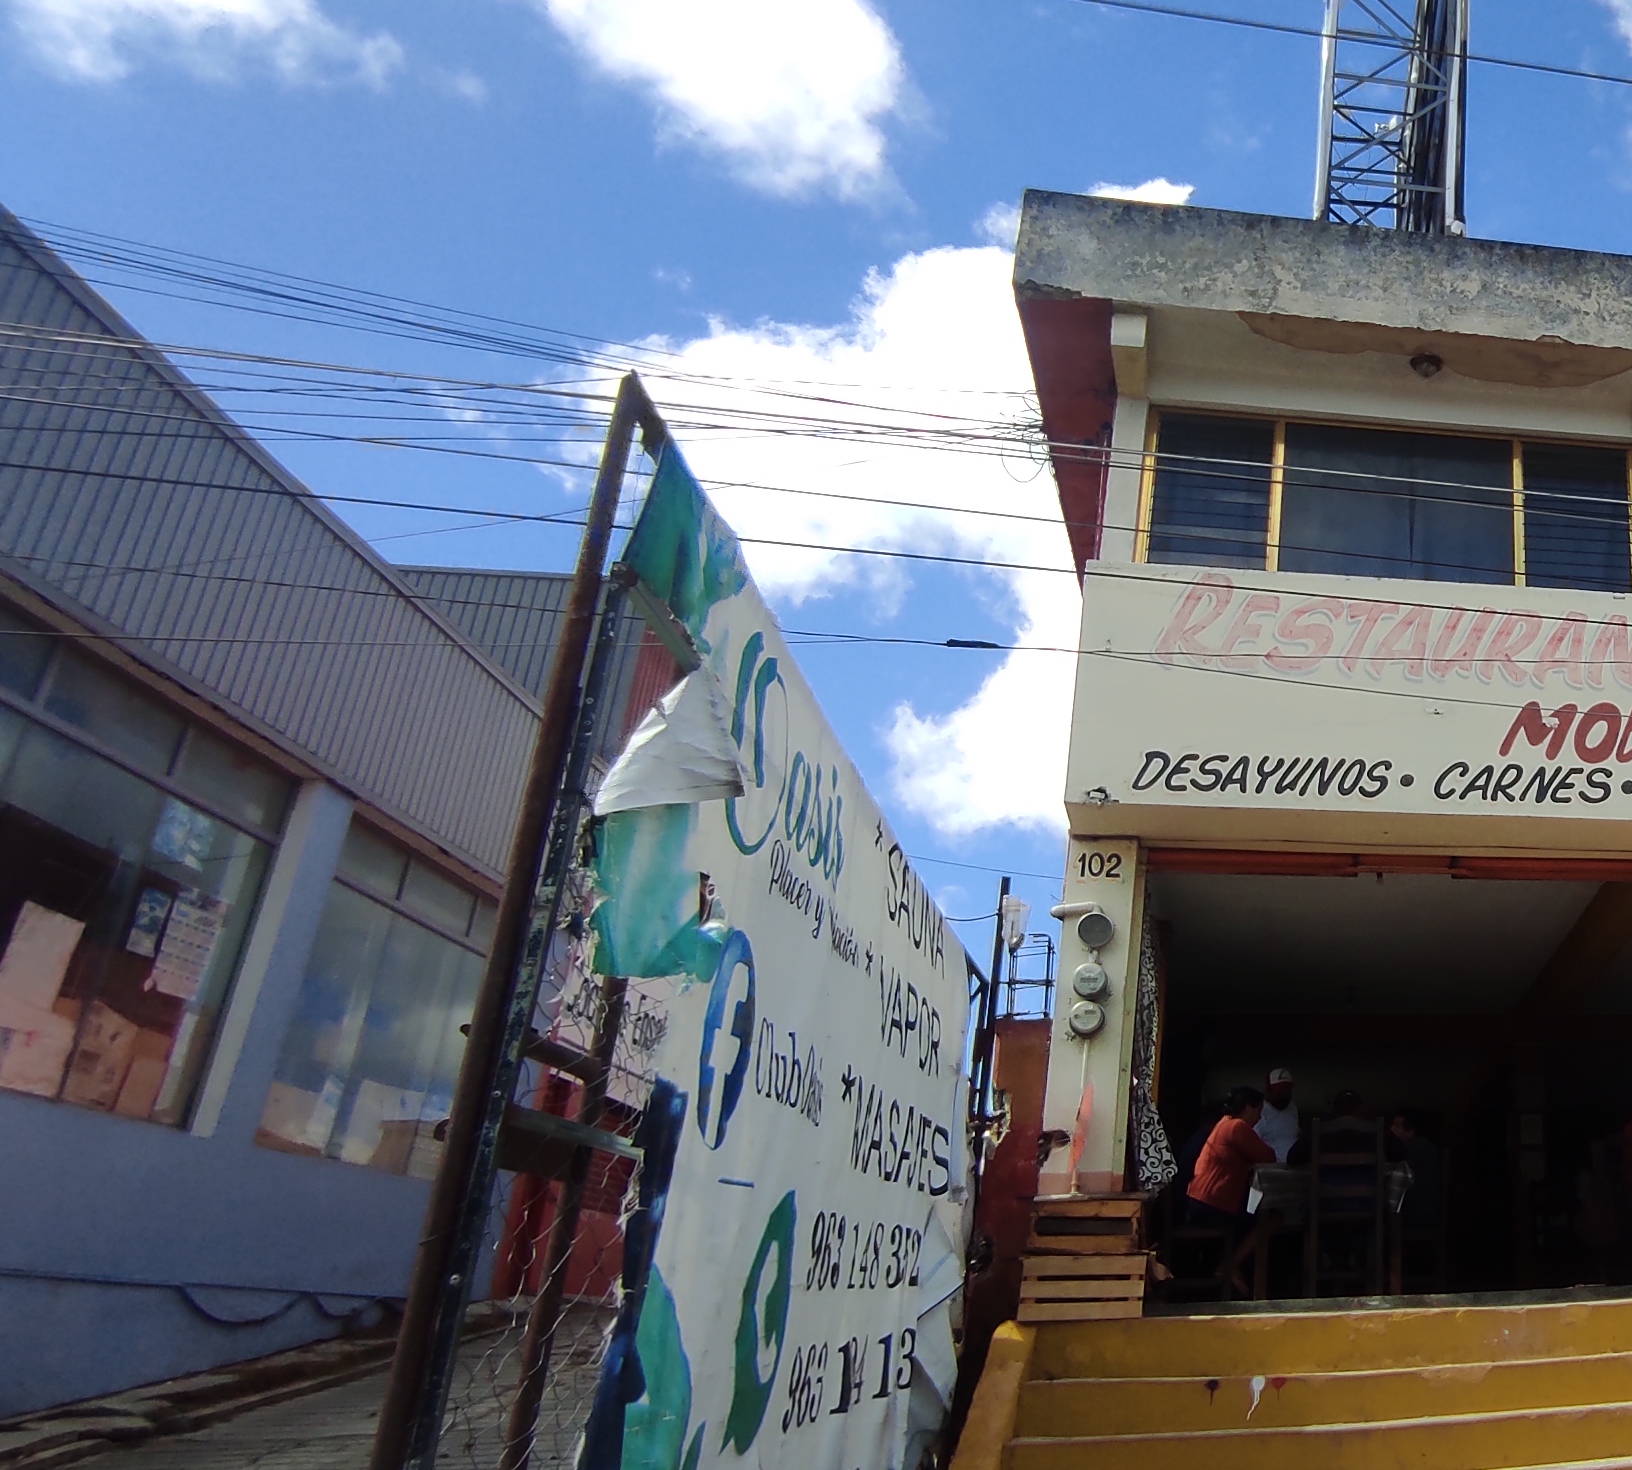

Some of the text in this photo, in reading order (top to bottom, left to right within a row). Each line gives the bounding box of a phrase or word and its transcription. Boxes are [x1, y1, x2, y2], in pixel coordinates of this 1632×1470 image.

[1132, 751, 1391, 798] DESAYUNOS
[1433, 761, 1612, 804] CARNES
[886, 842, 946, 975] SAUNA
[1078, 852, 1122, 878] 102
[755, 1016, 801, 1109] Club
[880, 956, 941, 1079] VAPOR
[851, 1075, 949, 1197] MASAJES
